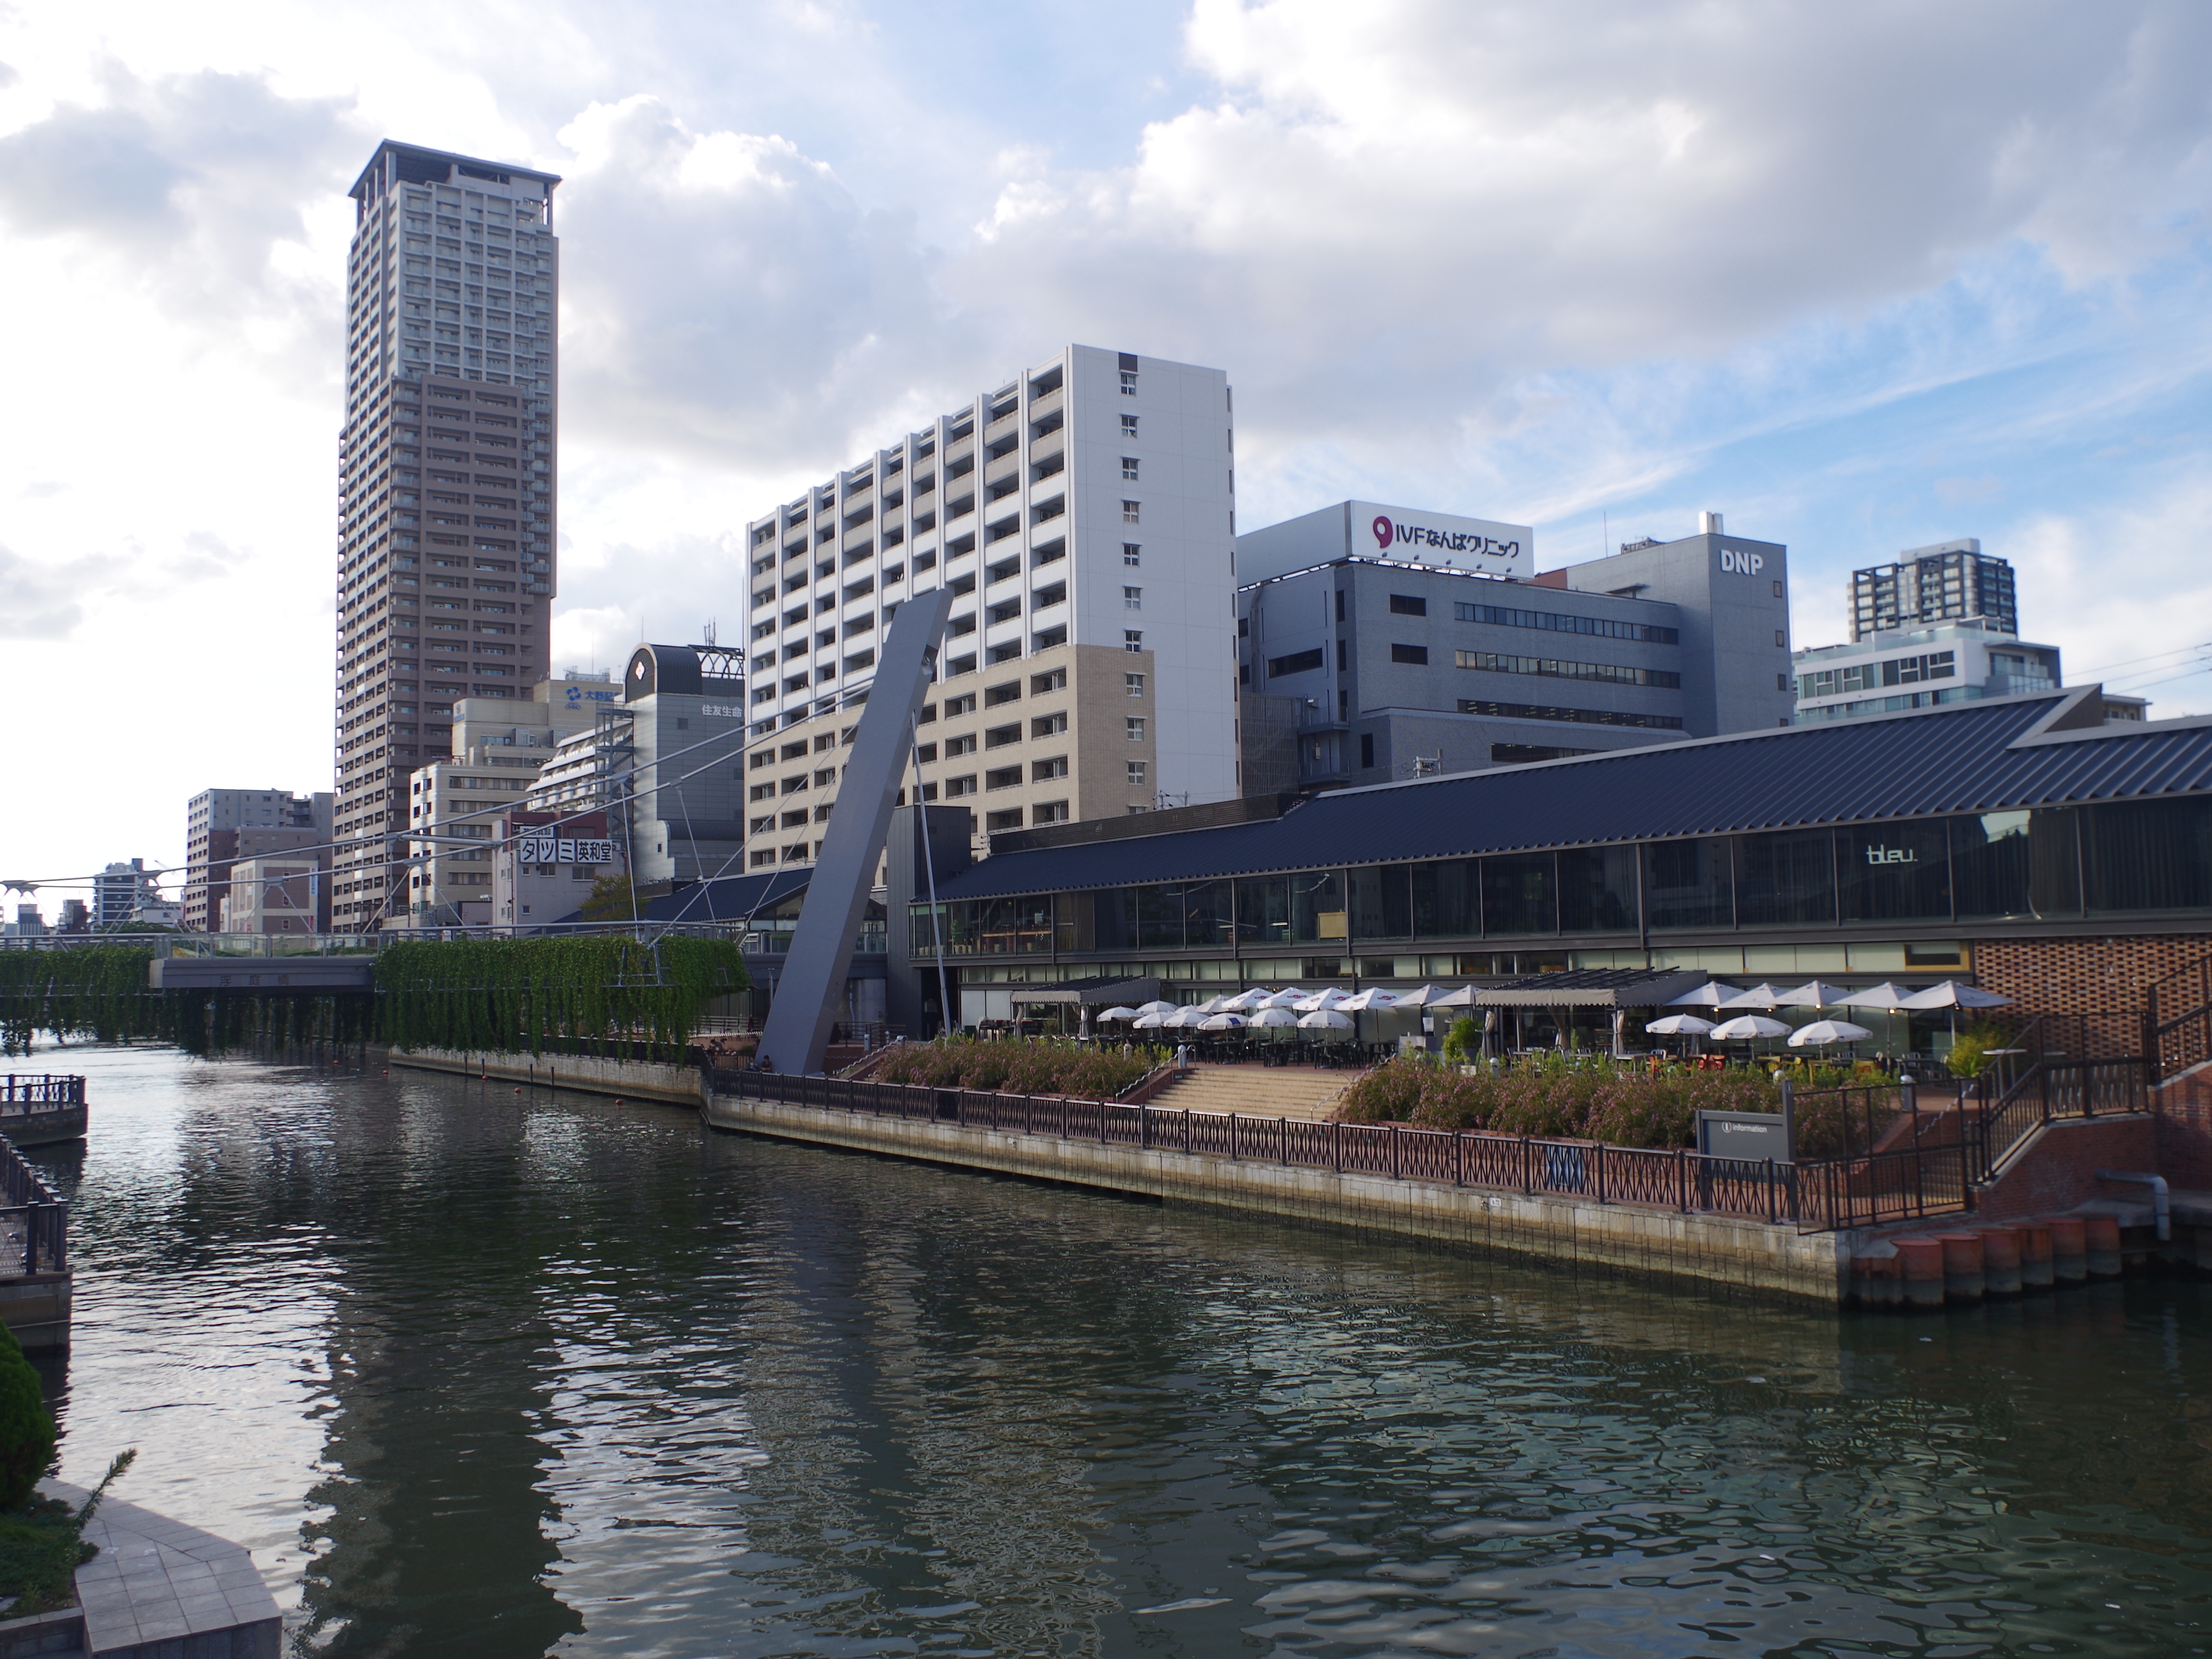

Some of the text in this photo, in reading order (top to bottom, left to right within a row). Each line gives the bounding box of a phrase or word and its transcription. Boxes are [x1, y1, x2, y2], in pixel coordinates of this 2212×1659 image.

[1396, 524, 1519, 558] IVFなんばクリニック
[1720, 549, 1763, 575] DNP
[701, 704, 743, 718] 住友生命
[1732, 1123, 1767, 1133] information
